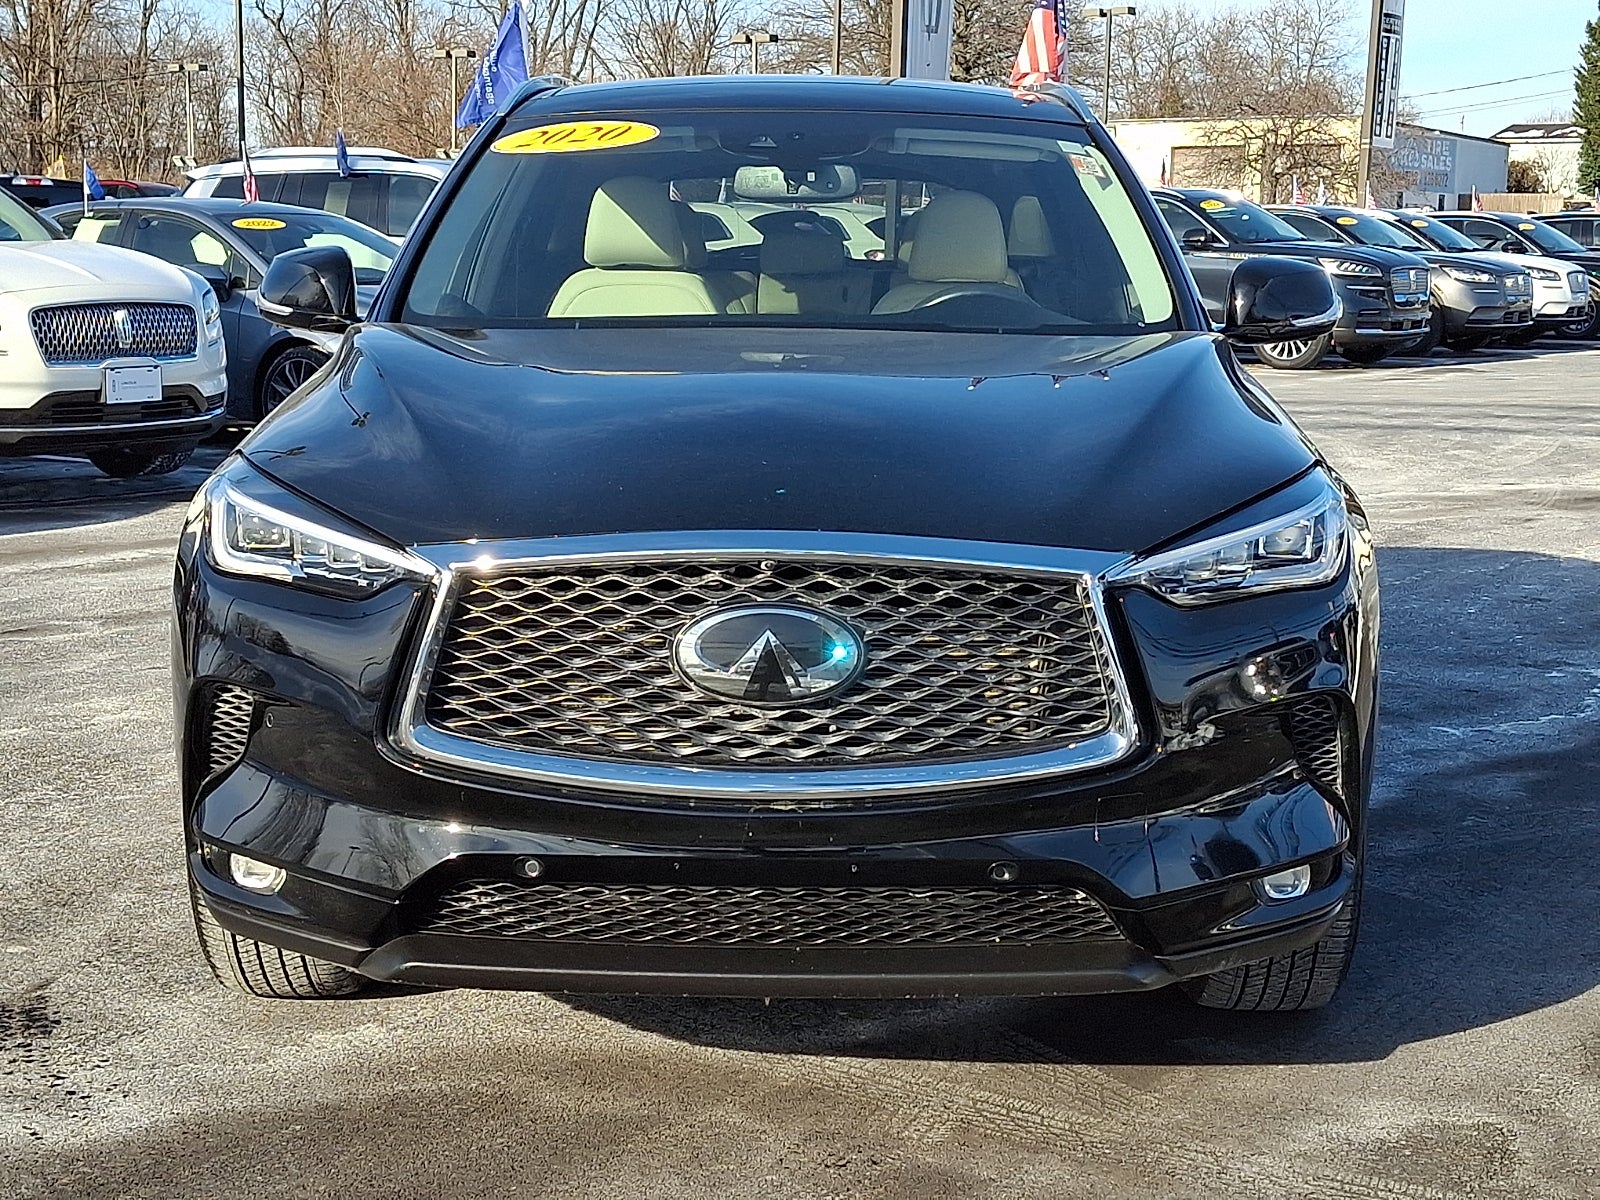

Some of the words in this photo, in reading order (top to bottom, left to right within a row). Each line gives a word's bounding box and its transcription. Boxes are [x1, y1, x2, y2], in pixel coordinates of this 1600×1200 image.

[511, 125, 633, 149] 2020
[1425, 138, 1450, 156] TIRE
[1420, 153, 1453, 172] SALES
